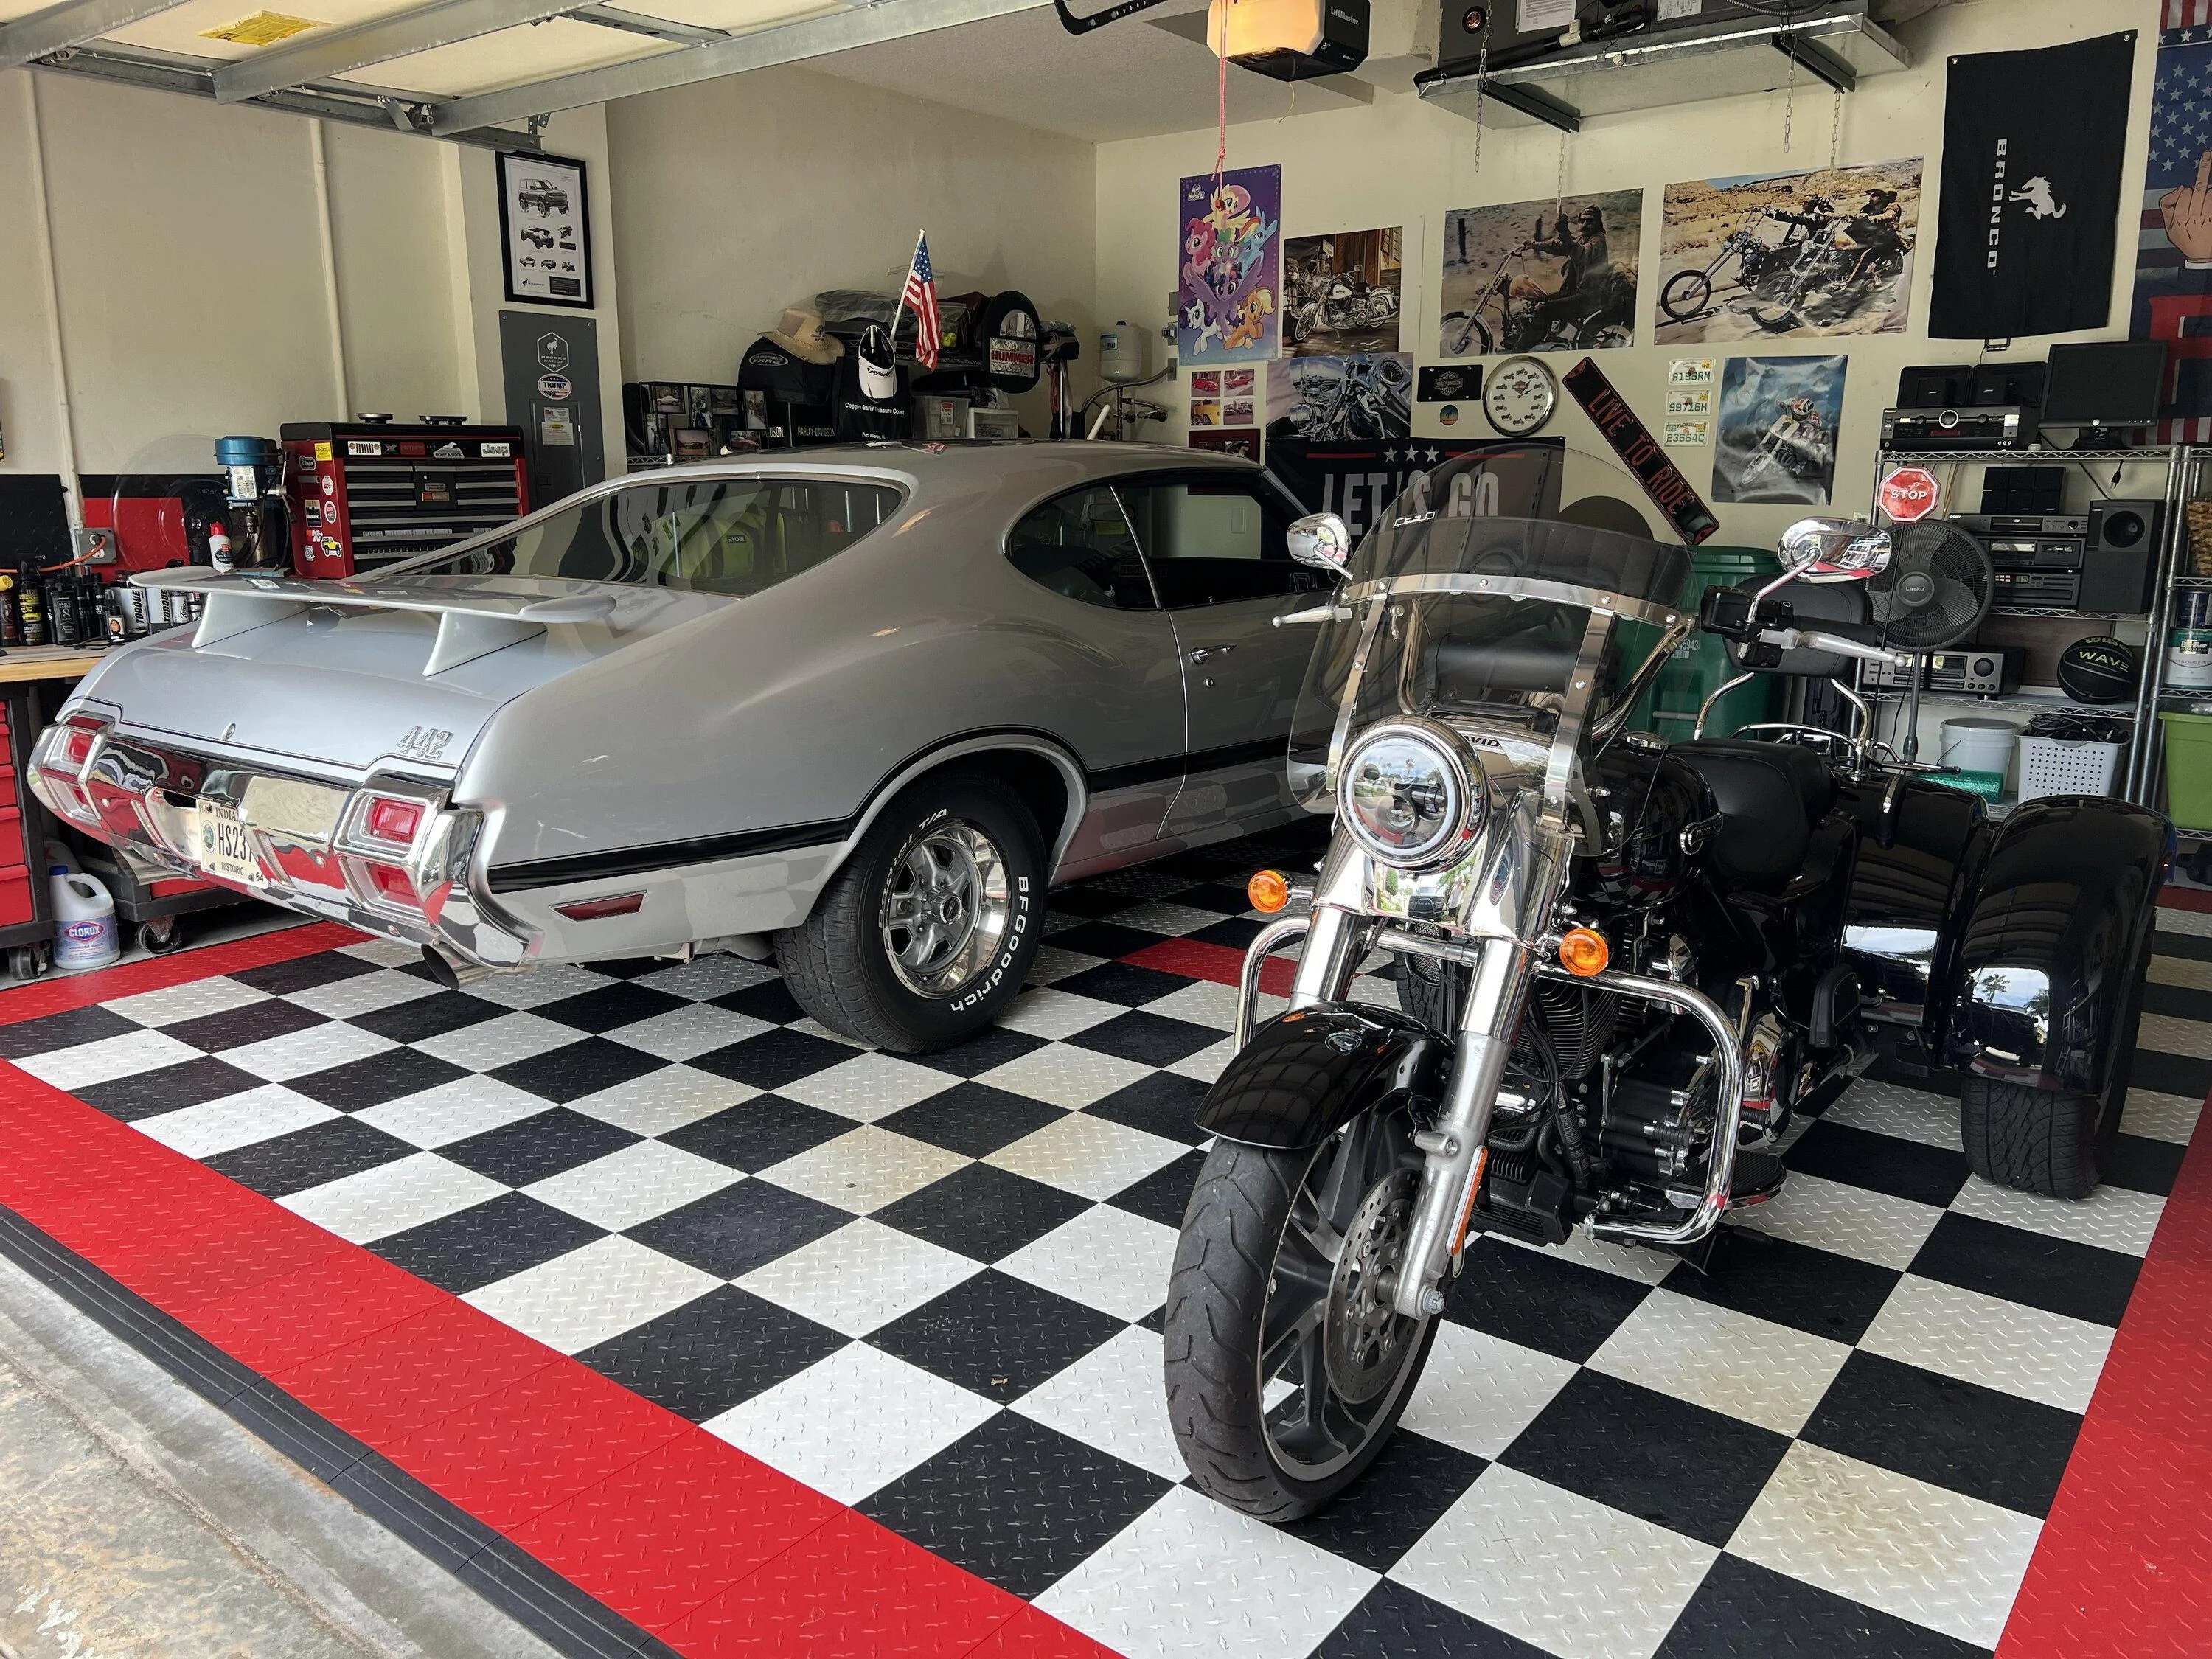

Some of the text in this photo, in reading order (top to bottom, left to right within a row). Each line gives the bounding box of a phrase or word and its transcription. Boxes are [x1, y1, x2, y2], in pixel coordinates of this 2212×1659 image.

[1330, 6, 1360, 26] LiftMaster
[1987, 138, 2007, 268] BRONCO
[991, 349, 1034, 365] HUMMER
[845, 402, 861, 411] Coggin
[797, 426, 835, 437] HARLEY-DAVIDSON
[482, 443, 509, 456] Jeep
[1587, 389, 1695, 515] LIVE TO RIDE
[1322, 469, 1430, 536] LET'S
[1890, 489, 1928, 500] STOP
[132, 589, 145, 625] TORQUE
[2079, 650, 2130, 672] WAVE
[396, 726, 453, 760] 442
[919, 808, 947, 831] T/A
[221, 861, 244, 876] HISTORIC
[255, 872, 264, 883] 64
[69, 925, 100, 938] CLOROX
